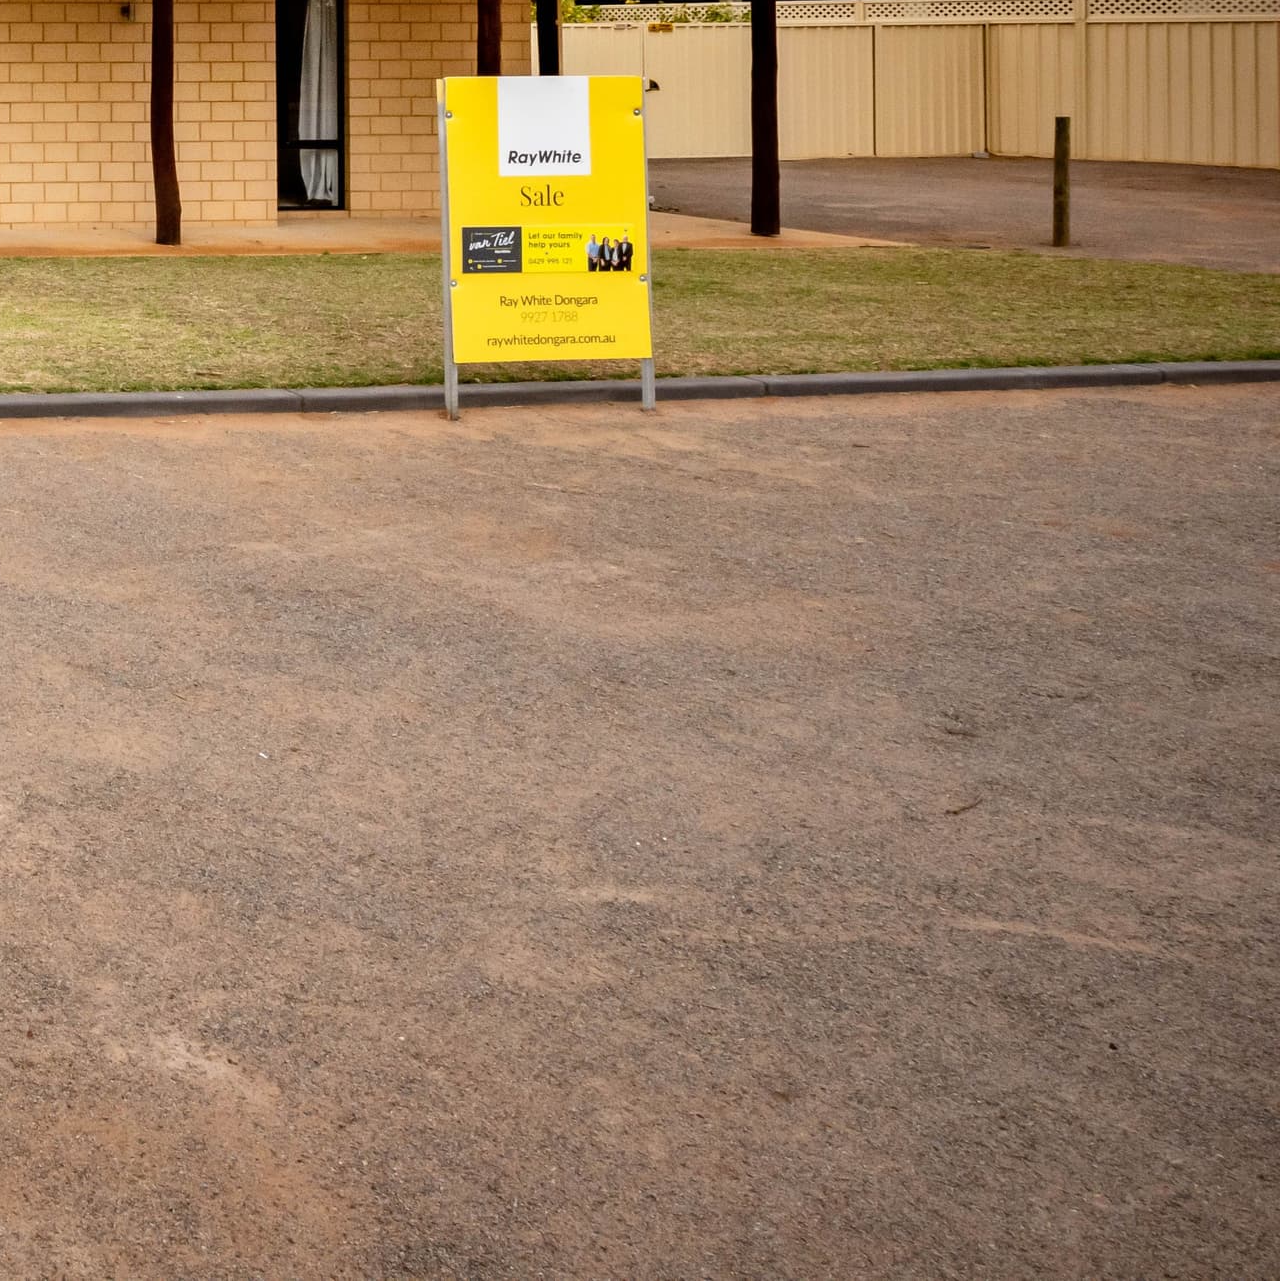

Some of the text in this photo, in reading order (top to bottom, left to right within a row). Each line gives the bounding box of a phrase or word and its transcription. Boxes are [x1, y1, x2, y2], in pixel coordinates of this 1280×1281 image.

[520, 184, 565, 207] Sale
[490, 230, 515, 247] Tiel
[528, 232, 540, 240] Let
[558, 231, 583, 240] family
[528, 241, 571, 249] help yours
[500, 294, 598, 308] Ray White Dongara
[520, 310, 579, 323] 9927 1788
[487, 333, 616, 348] raywhitedongara.com.au
